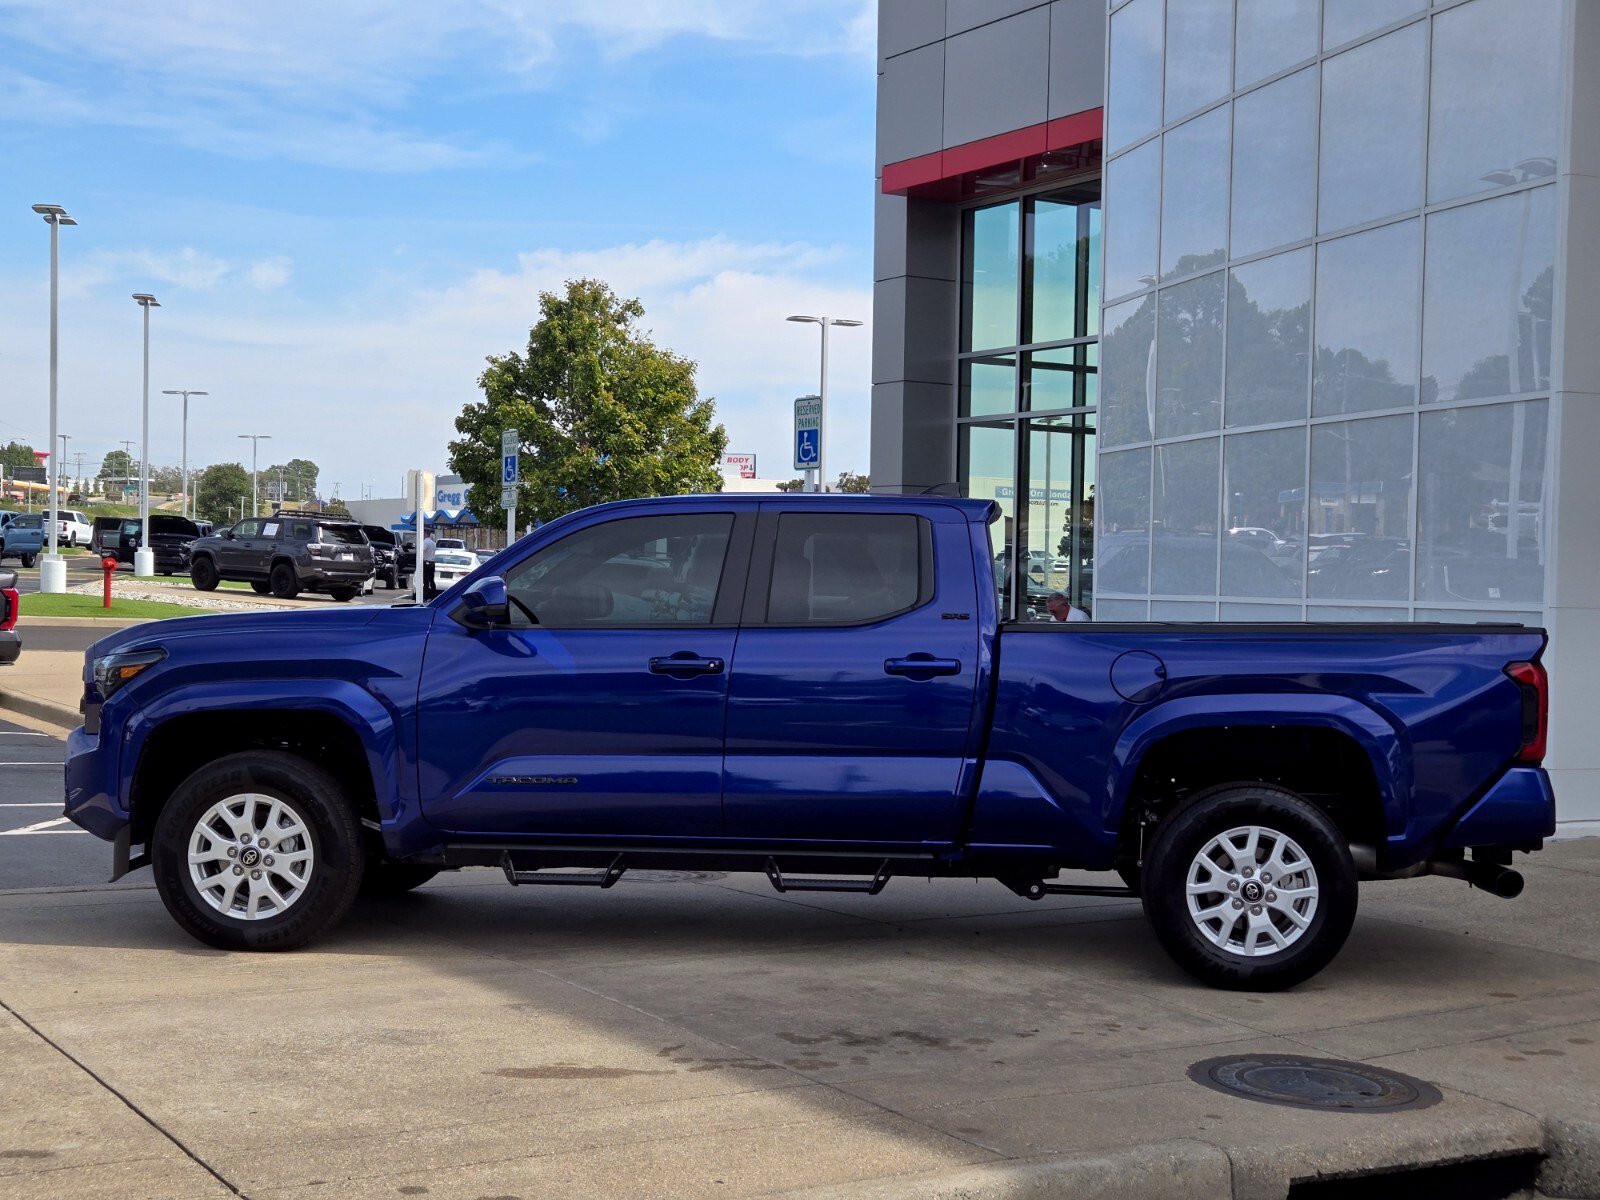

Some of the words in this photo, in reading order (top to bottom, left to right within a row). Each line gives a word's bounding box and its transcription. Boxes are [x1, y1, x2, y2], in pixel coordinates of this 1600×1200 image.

[797, 404, 820, 416] RESERVED
[798, 417, 819, 428] PARKING
[437, 490, 461, 506] Gregg
[487, 776, 578, 785] TACOMA
